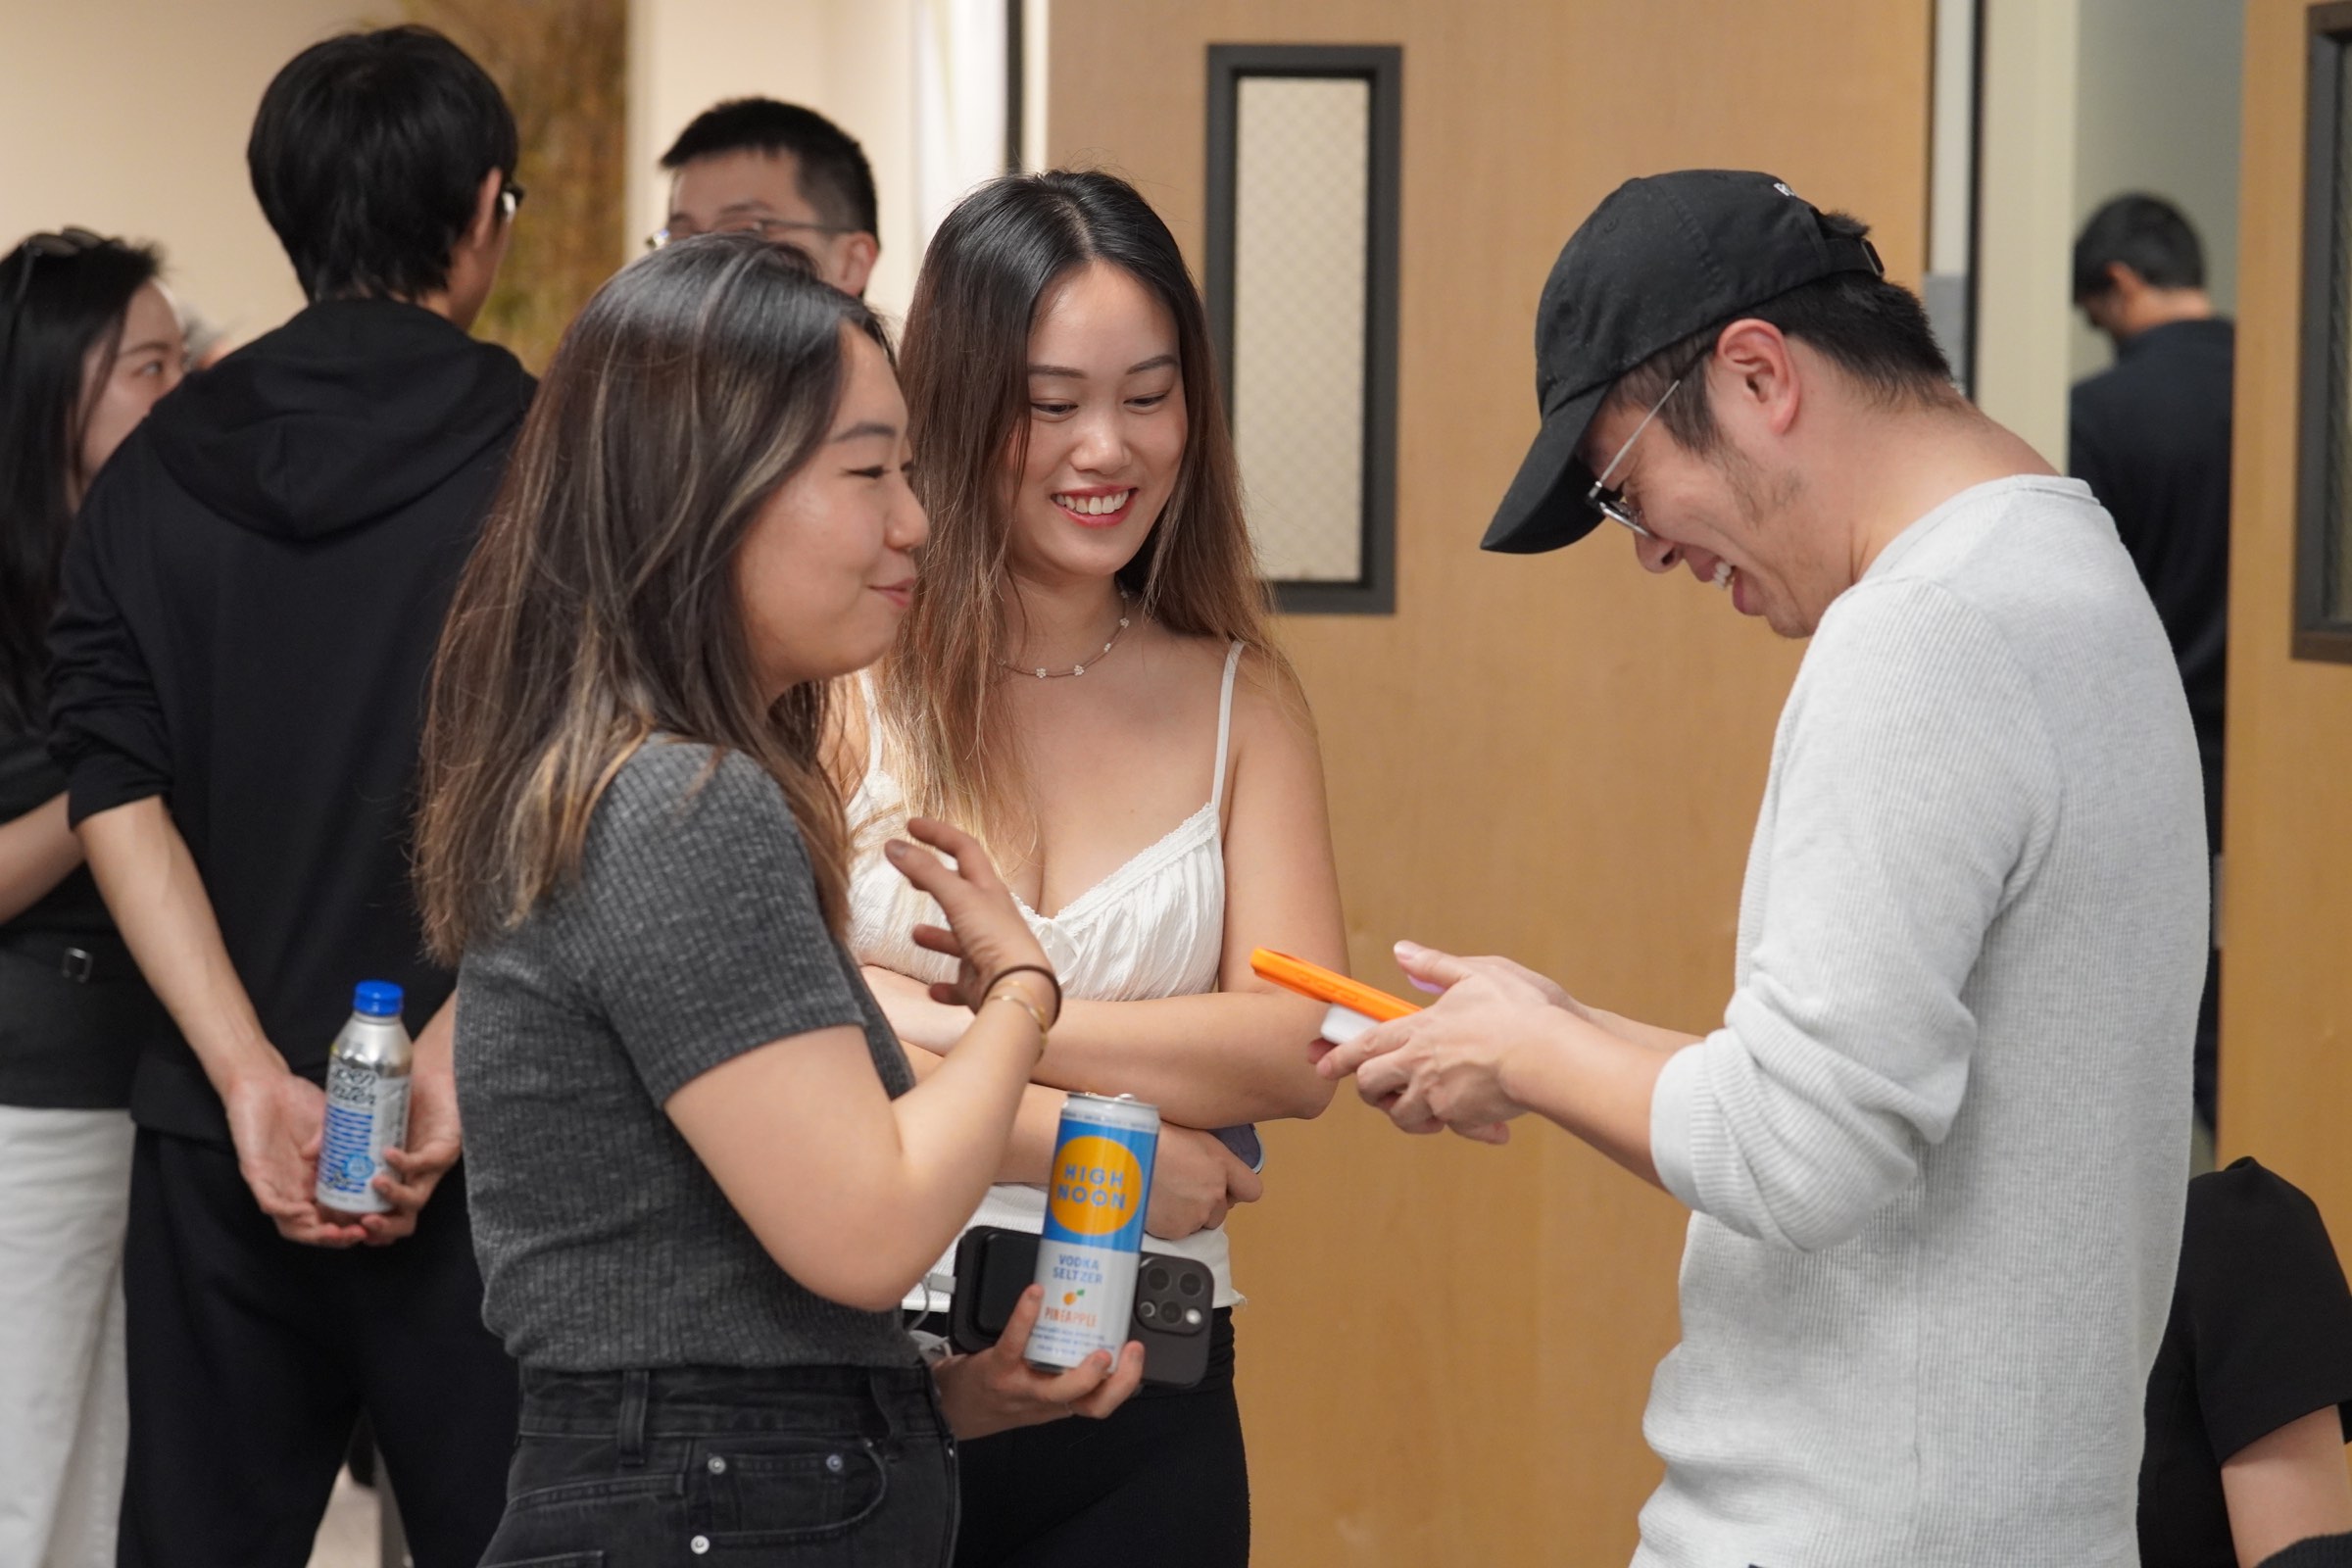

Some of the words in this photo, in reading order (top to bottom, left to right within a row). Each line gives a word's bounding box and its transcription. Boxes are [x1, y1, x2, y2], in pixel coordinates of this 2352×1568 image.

[1064, 1163, 1125, 1189] HIGH
[1056, 1184, 1127, 1210] NOON
[1058, 1253, 1100, 1270] VODKA
[1053, 1266, 1103, 1284] SELTZER
[1044, 1305, 1098, 1328] PINEAPPLE
